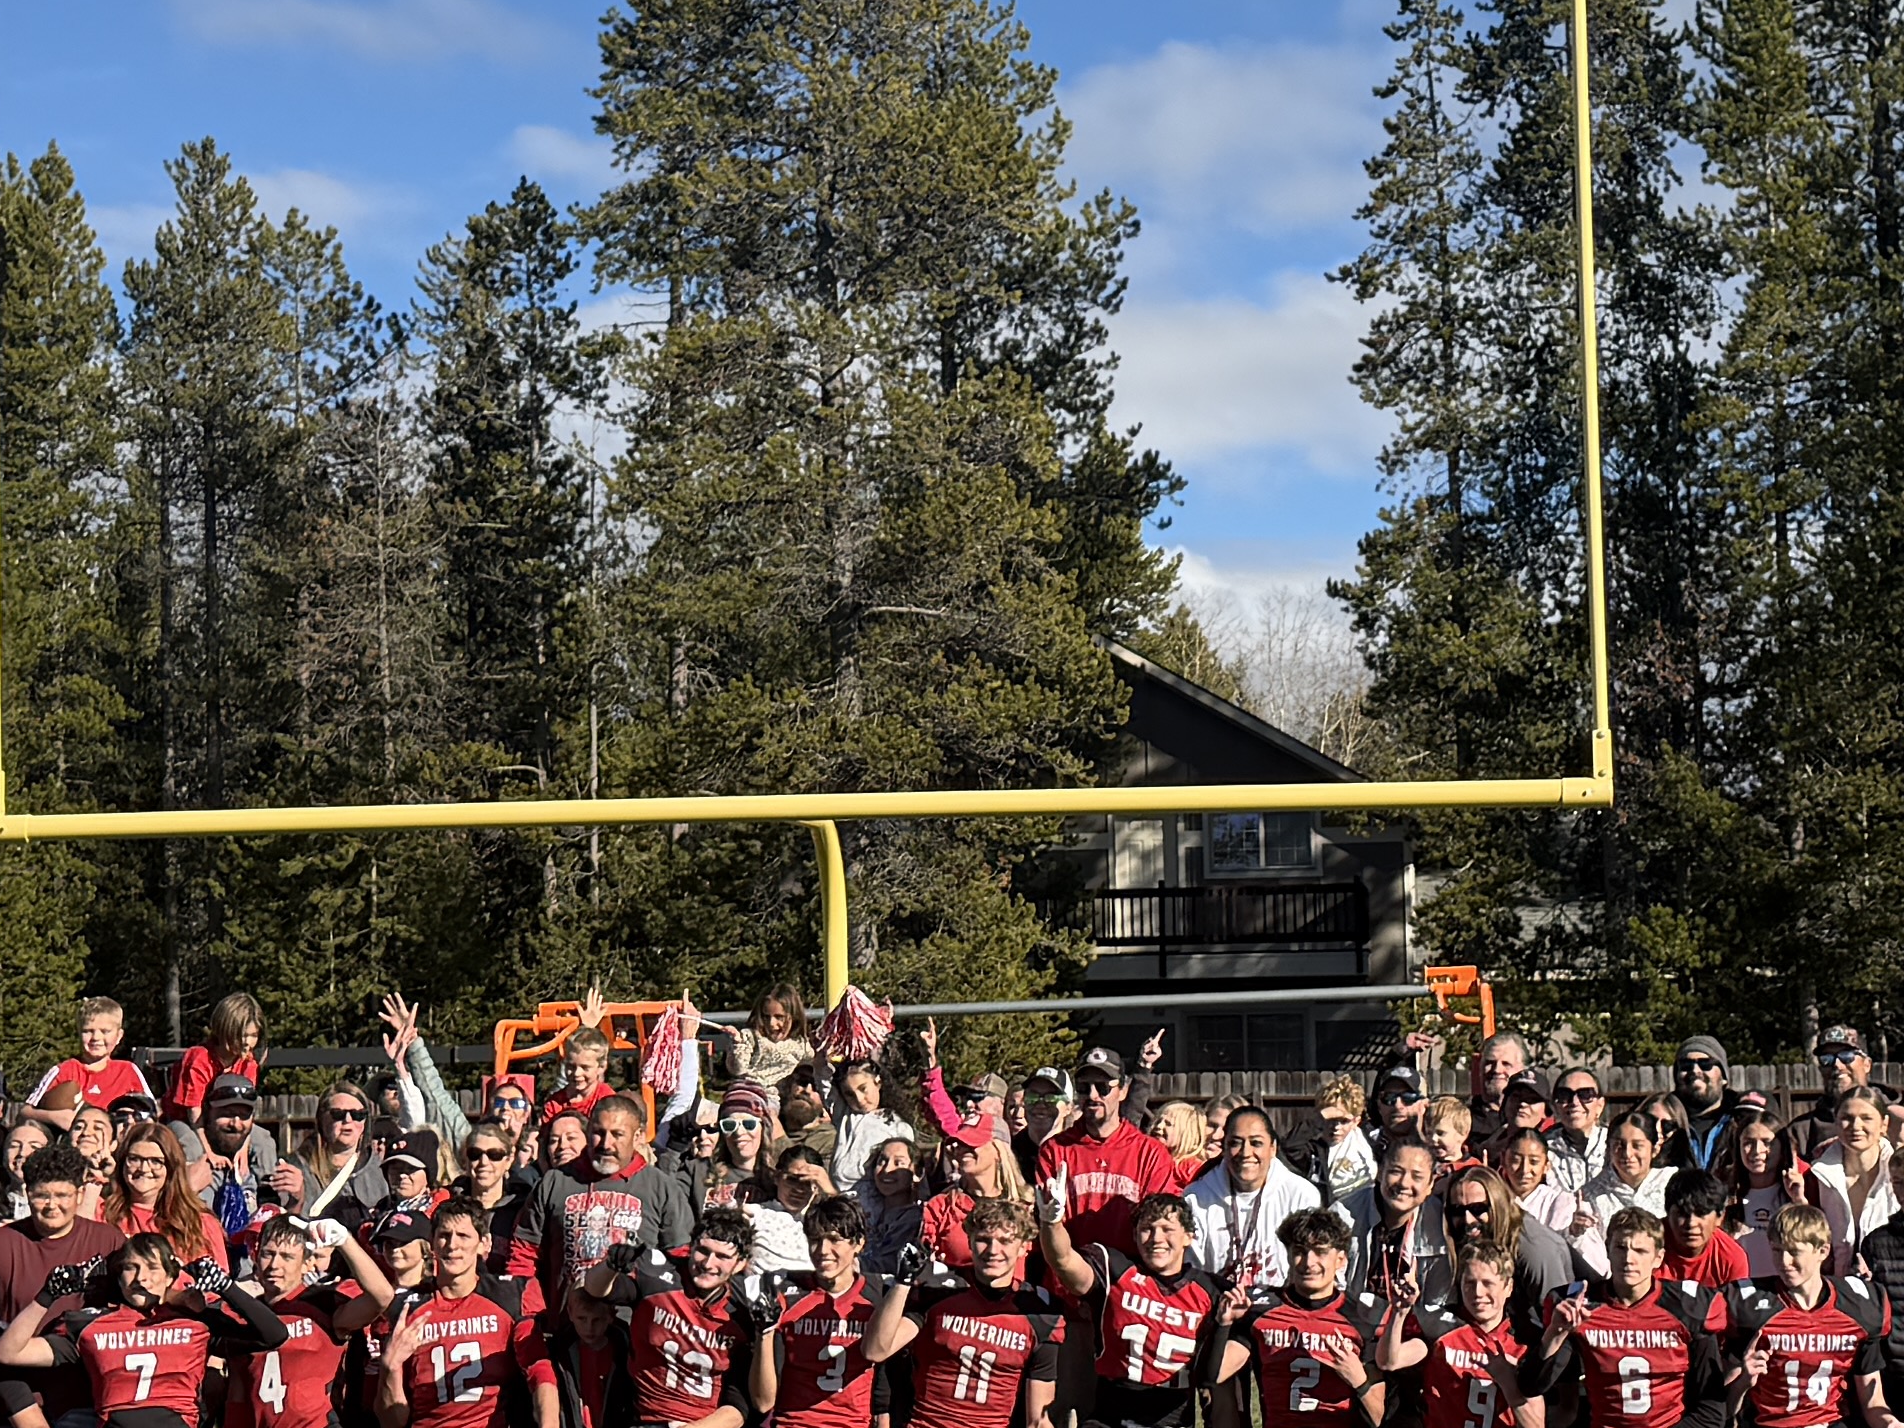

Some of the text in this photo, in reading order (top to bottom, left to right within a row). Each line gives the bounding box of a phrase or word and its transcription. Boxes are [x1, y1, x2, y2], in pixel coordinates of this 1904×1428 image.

[653, 1305, 736, 1351] WOLVERINES
[942, 1313, 1028, 1352] WOLVERINES
[1121, 1290, 1202, 1332] WEST
[94, 1328, 193, 1351] WOLVERINES
[1121, 1323, 1197, 1388] 15
[1585, 1329, 1679, 1349] WOLVERINES
[1767, 1333, 1858, 1352] WOLVERINES
[124, 1352, 158, 1402] 7
[258, 1350, 287, 1415] 4
[430, 1341, 485, 1403] 12
[662, 1340, 714, 1399] 13
[816, 1344, 847, 1392] 3
[954, 1345, 997, 1404] 11
[1289, 1357, 1321, 1411] 2
[1617, 1355, 1652, 1414] 6
[1784, 1359, 1834, 1412] 14
